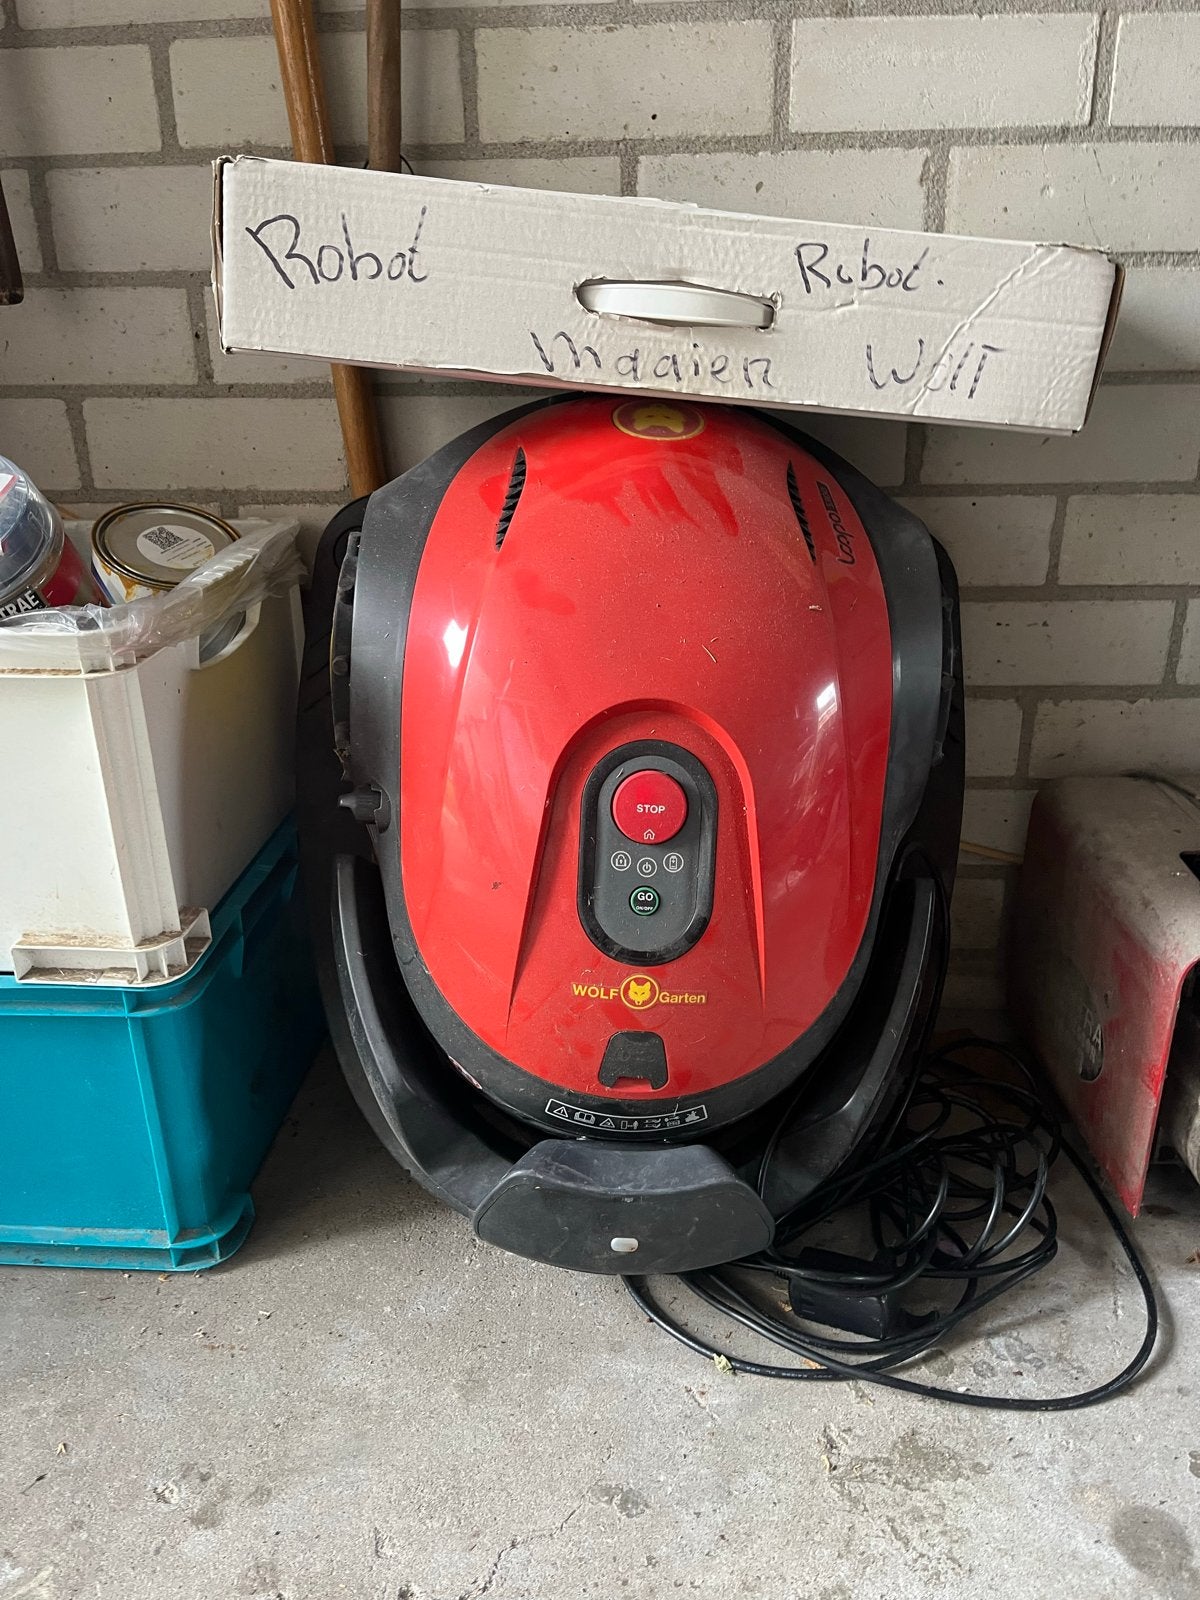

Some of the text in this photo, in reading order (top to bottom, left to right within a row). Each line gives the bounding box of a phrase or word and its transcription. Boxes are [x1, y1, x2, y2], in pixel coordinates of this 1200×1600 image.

[246, 205, 428, 290] Robot
[636, 803, 666, 814] STOP
[637, 892, 654, 902] GO
[572, 983, 706, 1004] WOLF Garten
